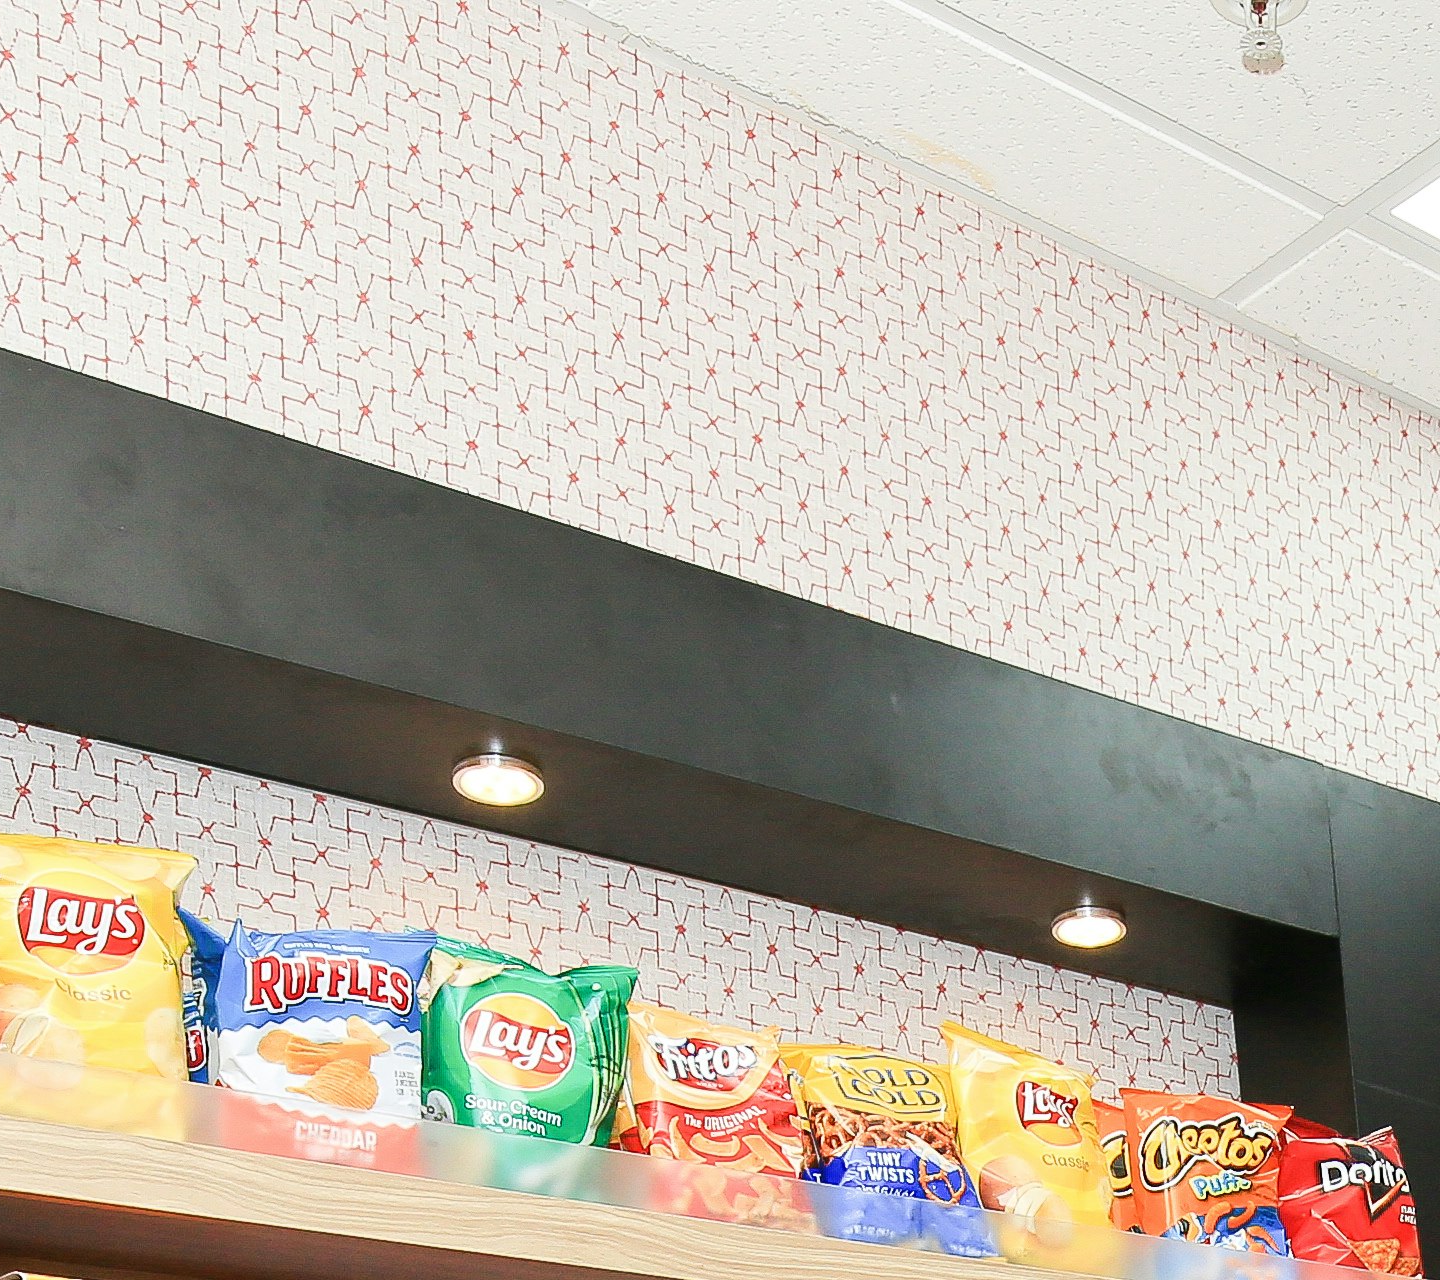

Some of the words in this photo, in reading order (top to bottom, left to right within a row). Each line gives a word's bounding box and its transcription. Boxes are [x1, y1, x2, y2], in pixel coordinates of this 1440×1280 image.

[26, 888, 138, 954] Lay's
[55, 977, 133, 1002] Classic
[249, 954, 410, 1012] RUFFLES
[473, 1011, 568, 1071] Lay's
[648, 1035, 757, 1081] Fritos
[465, 1094, 506, 1111] Sour
[509, 1098, 562, 1126] Cream
[704, 1106, 767, 1130] ORIGINAL
[1023, 1082, 1077, 1127] Lay's
[295, 1121, 377, 1151] CHEDDAR
[480, 1110, 496, 1125] &
[499, 1113, 547, 1136] Onion
[866, 1151, 901, 1167] TINY
[1141, 1114, 1275, 1189] Cheetos
[856, 1166, 915, 1184] TWISTS
